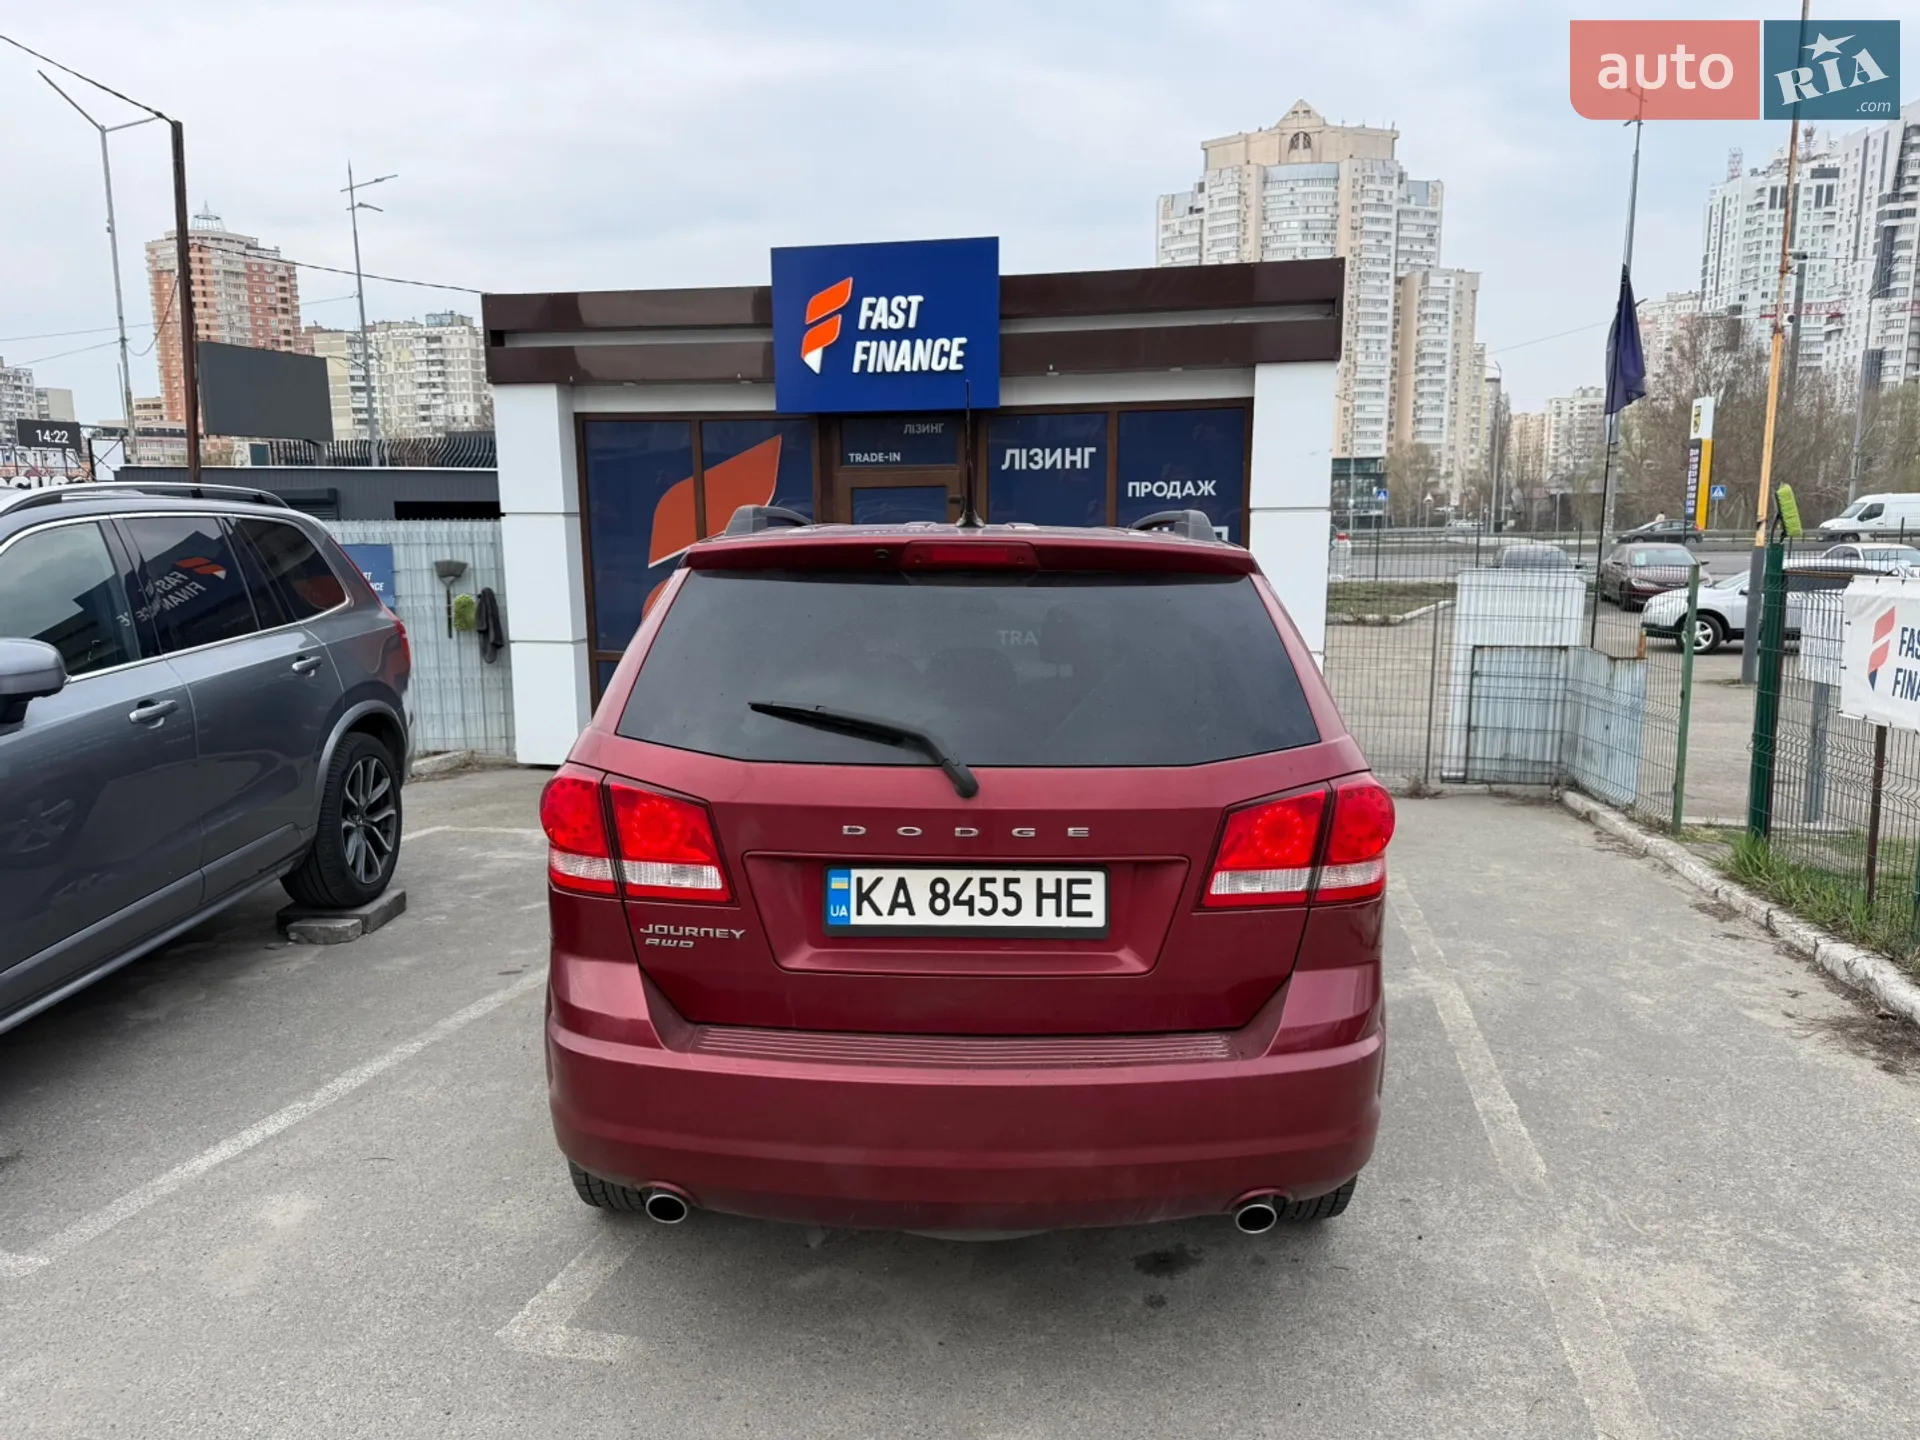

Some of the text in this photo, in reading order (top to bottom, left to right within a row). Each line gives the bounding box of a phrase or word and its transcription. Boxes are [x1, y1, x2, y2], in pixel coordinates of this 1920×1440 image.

[858, 295, 924, 330] FAST
[852, 337, 968, 373] FINANCE
[903, 422, 944, 434] ЛІЗИНГ
[36, 429, 69, 444] 14:22
[848, 452, 901, 463] TRADE-IN
[1001, 447, 1097, 470] ЛІЗИНГ
[1127, 480, 1217, 499] ПРОДАЖ
[996, 629, 1040, 646] TRA
[843, 825, 1090, 837] DODGE
[830, 877, 1093, 918] UA KA 8455 HE
[640, 924, 746, 938] JOURNEY
[645, 938, 694, 948] AWD
